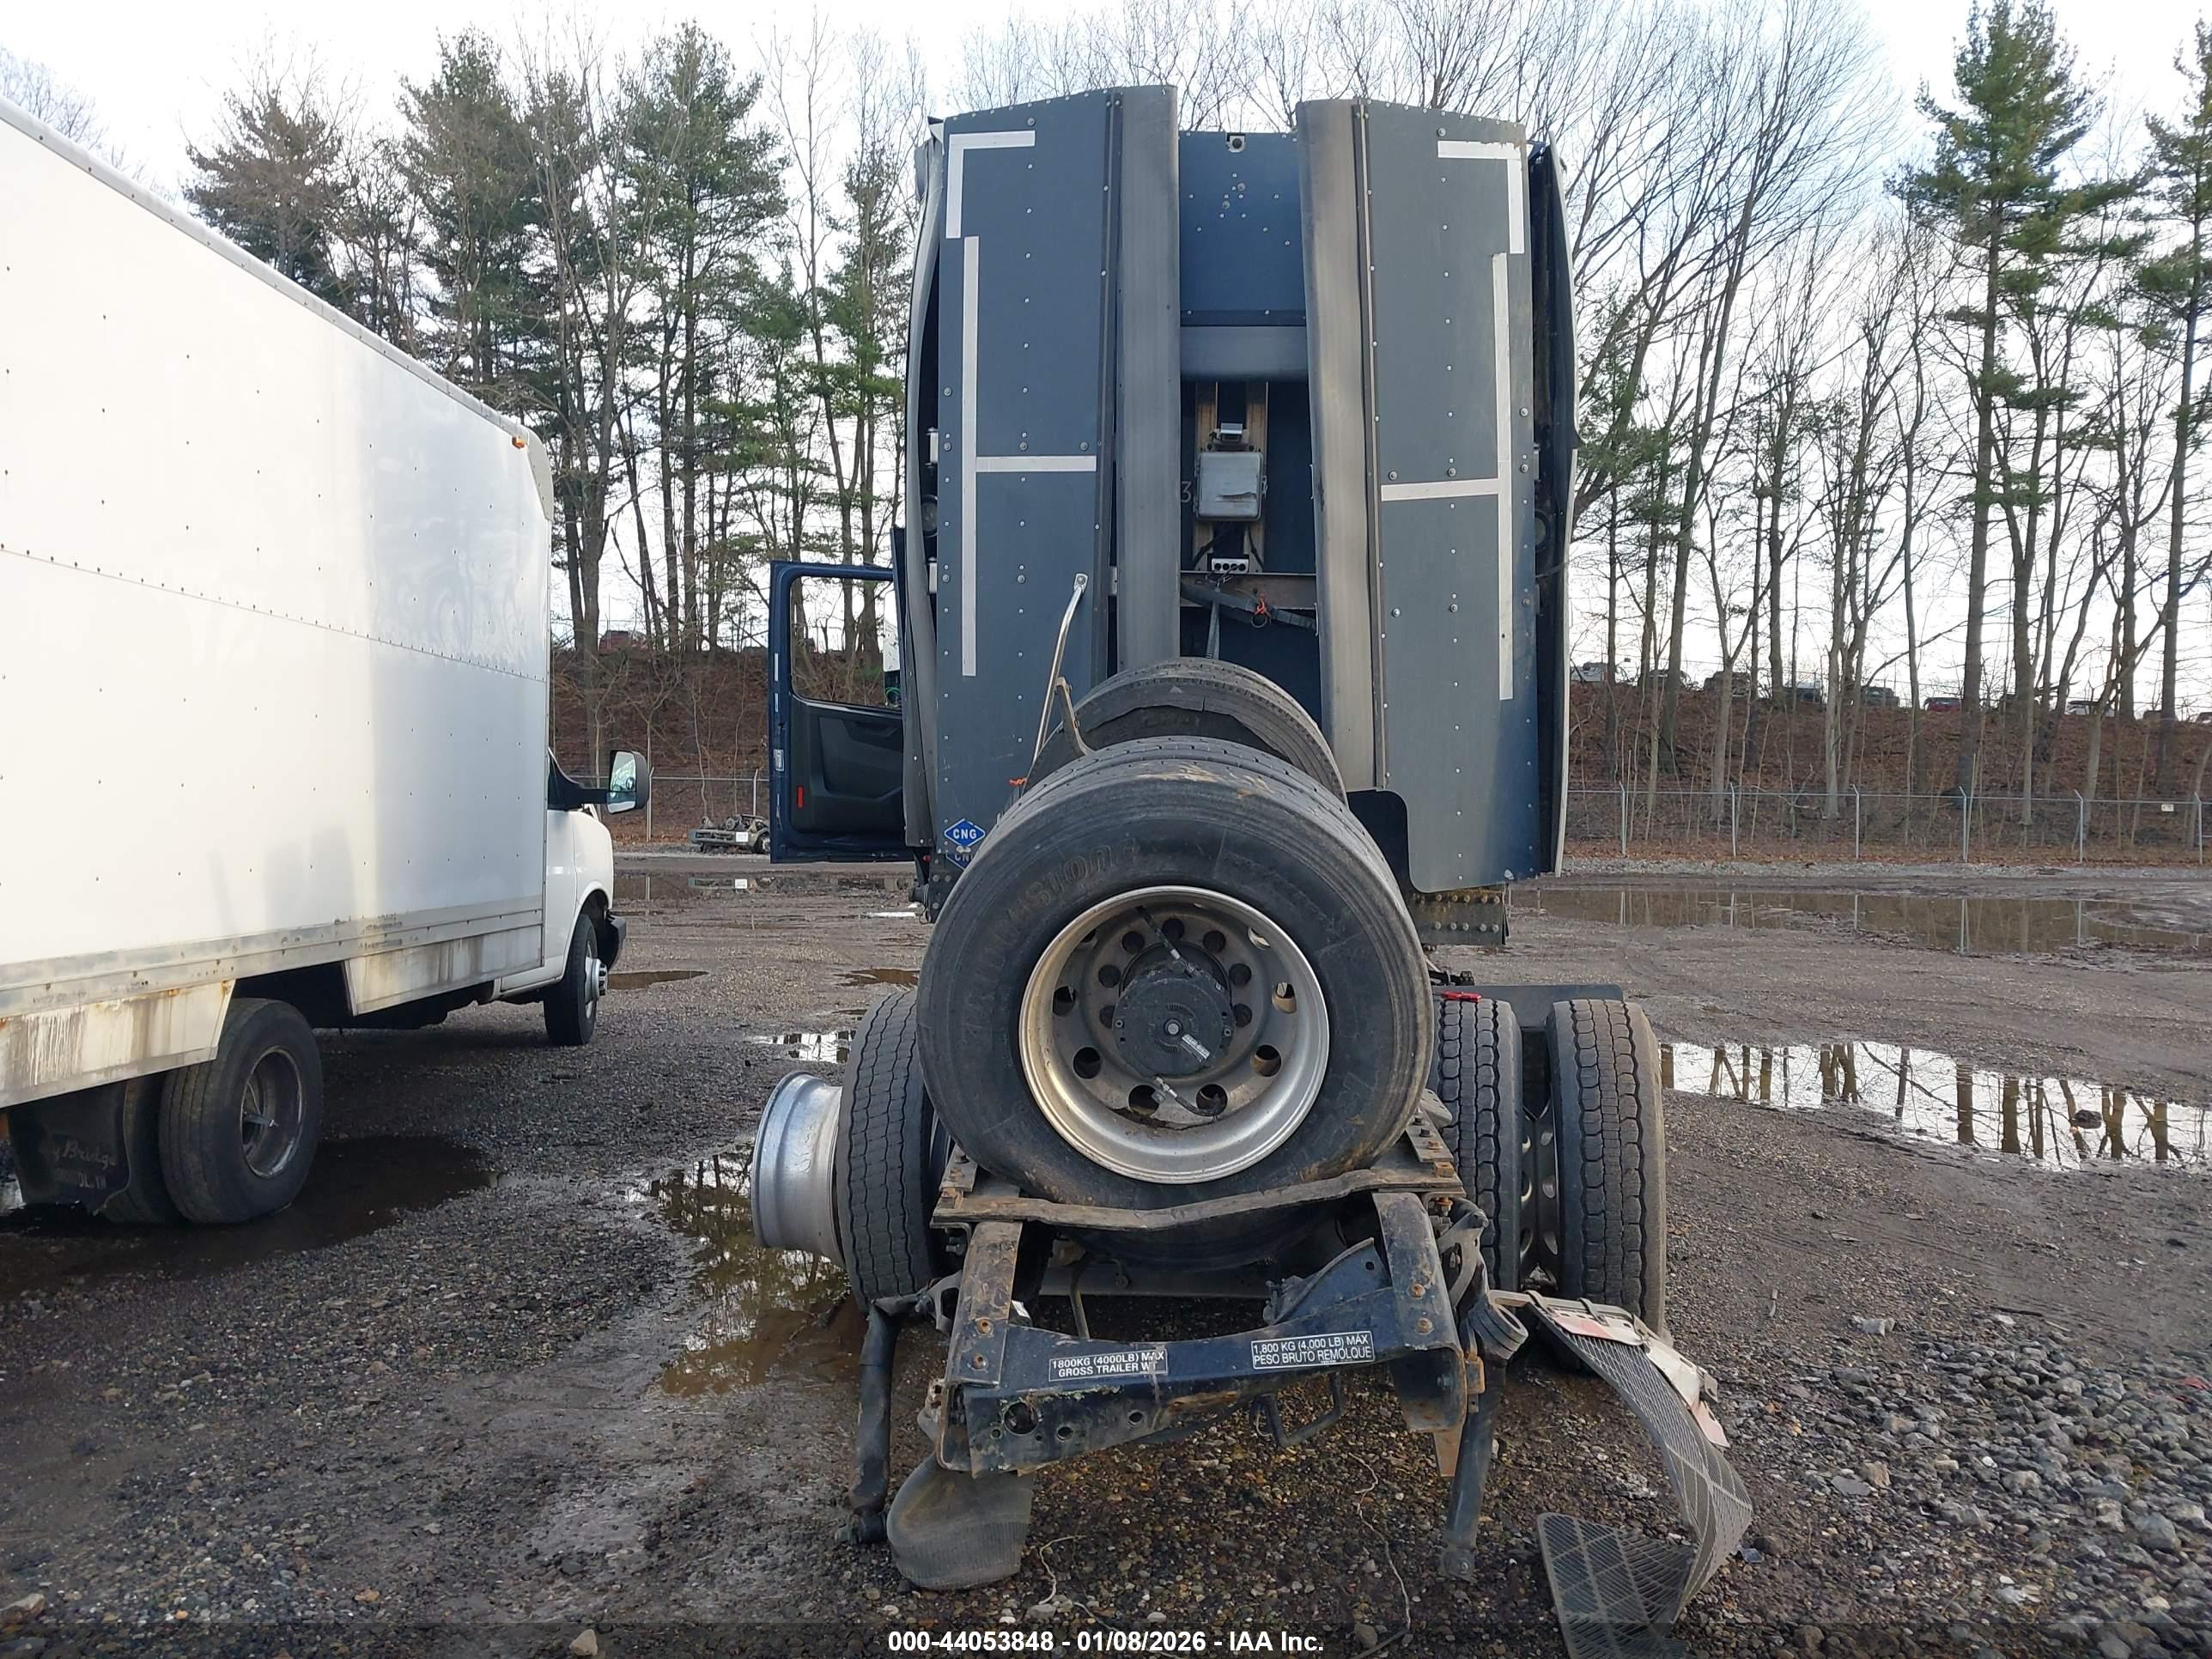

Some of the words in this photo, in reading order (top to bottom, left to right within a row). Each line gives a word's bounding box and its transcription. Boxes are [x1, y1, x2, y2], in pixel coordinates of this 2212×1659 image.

[952, 829, 977, 840] CNG
[1254, 1342, 1279, 1355] 1,800
[1281, 1340, 1296, 1352] KG
[1297, 1338, 1327, 1352] (4,000
[1328, 1336, 1345, 1348] LB)
[1053, 1357, 1091, 1370] 1800KG
[1093, 1352, 1139, 1366] (4000LB)
[1141, 1351, 1165, 1361] MAX
[1254, 1354, 1280, 1366] PESO
[1282, 1351, 1316, 1364] BRUTO
[1317, 1346, 1372, 1361] REMOLQUE
[1058, 1365, 1093, 1378] GROSS
[1096, 1362, 1139, 1375] TRAILER
